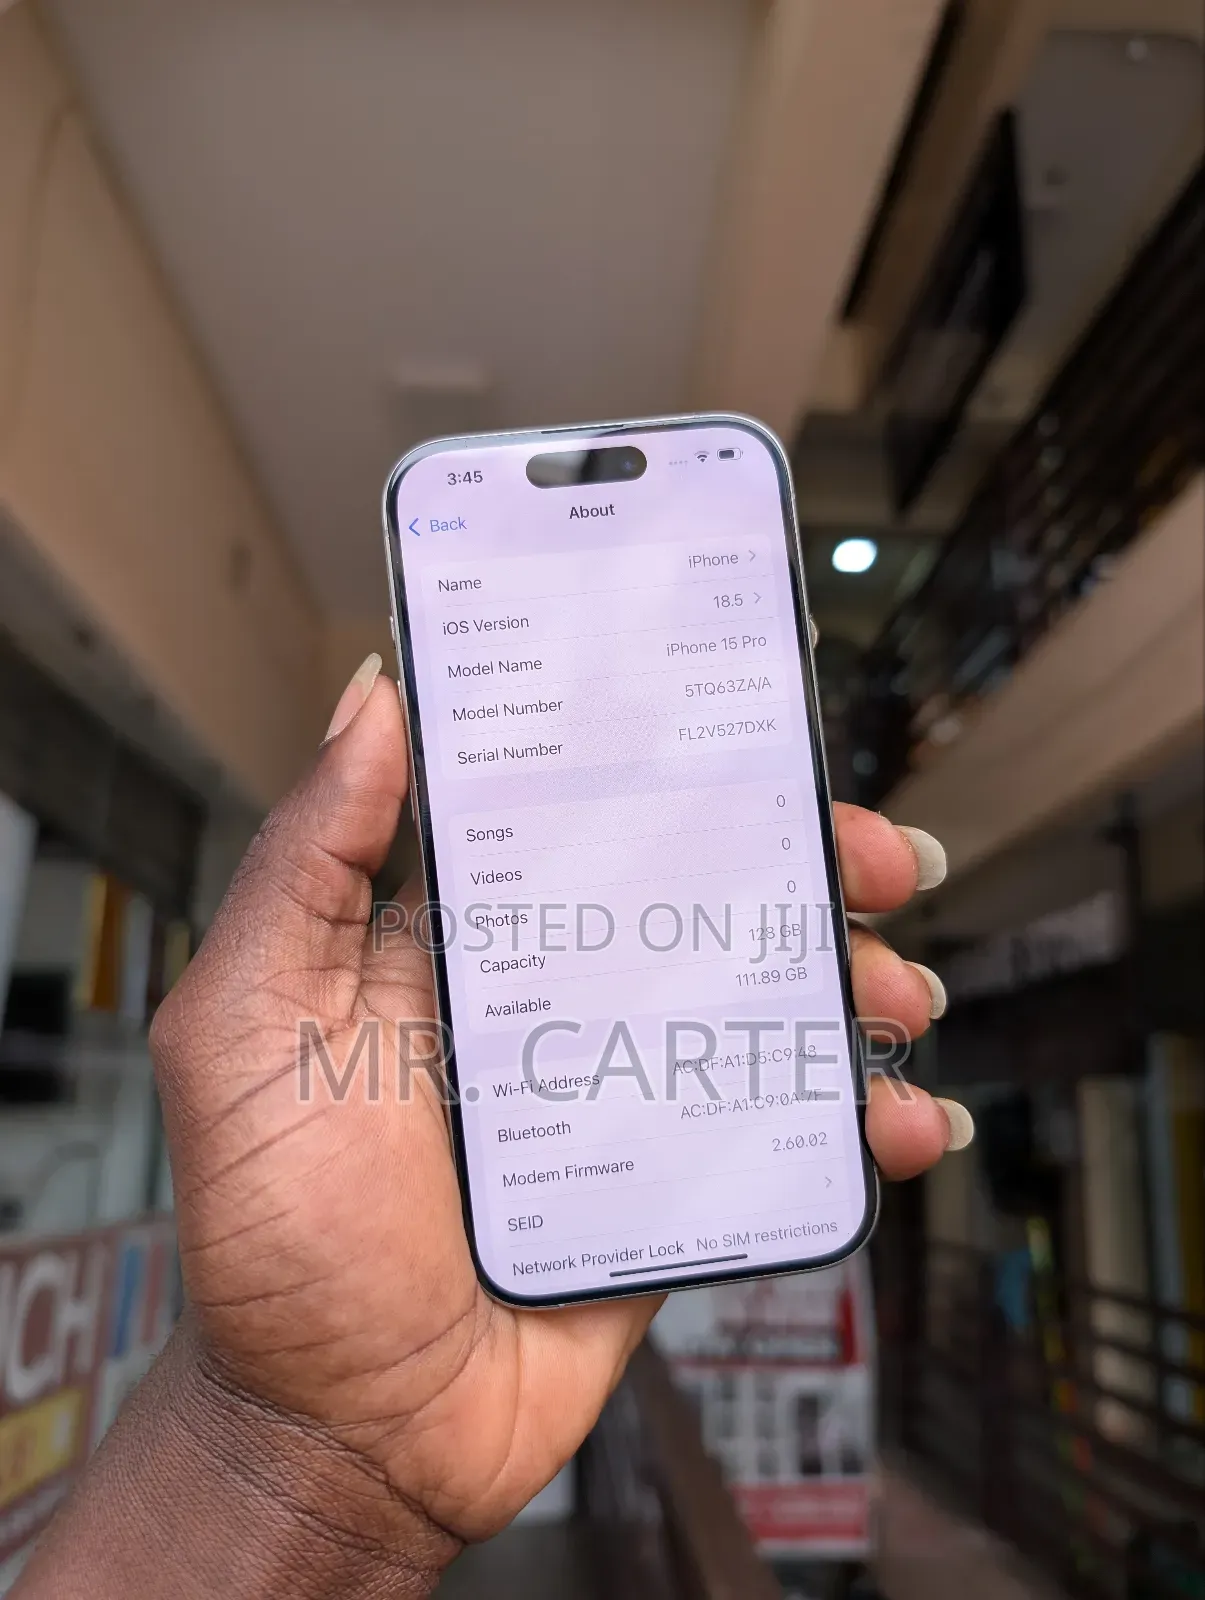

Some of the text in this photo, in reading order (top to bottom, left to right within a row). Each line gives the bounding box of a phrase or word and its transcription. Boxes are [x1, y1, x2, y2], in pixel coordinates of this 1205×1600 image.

[447, 470, 484, 486] 3:45
[569, 503, 616, 520] About
[430, 516, 468, 533] Back
[688, 552, 739, 570] iPhone
[438, 577, 482, 593] Name
[713, 594, 744, 609] 18.5
[442, 615, 530, 636] iOS Version
[666, 635, 767, 657] iPhone 15 Pro
[447, 658, 543, 680] Model Name
[685, 676, 772, 698] 5TQ63ZA/A
[452, 698, 563, 722] Model Number
[678, 718, 777, 741] FL2V527DXK
[457, 741, 563, 765] Serial Number
[776, 794, 786, 808] 0
[466, 825, 514, 844] Songs
[781, 837, 791, 851] 0
[470, 868, 523, 886] Videos
[787, 880, 797, 894] 0
[475, 911, 529, 930] Photos
[748, 923, 802, 941] 128 GB
[480, 954, 547, 974] Capacity
[735, 966, 808, 987] 111.89 GB
[484, 998, 552, 1018] Available
[492, 1072, 600, 1099] Wi-Fi Address
[498, 1120, 572, 1143] Bluetooth
[771, 1132, 828, 1152] 2.60.02
[502, 1159, 635, 1188] Modem Firmware
[507, 1214, 544, 1232] SEID
[696, 1220, 838, 1252] No SIM restrictions
[512, 1240, 685, 1276] Network Provider Lock
